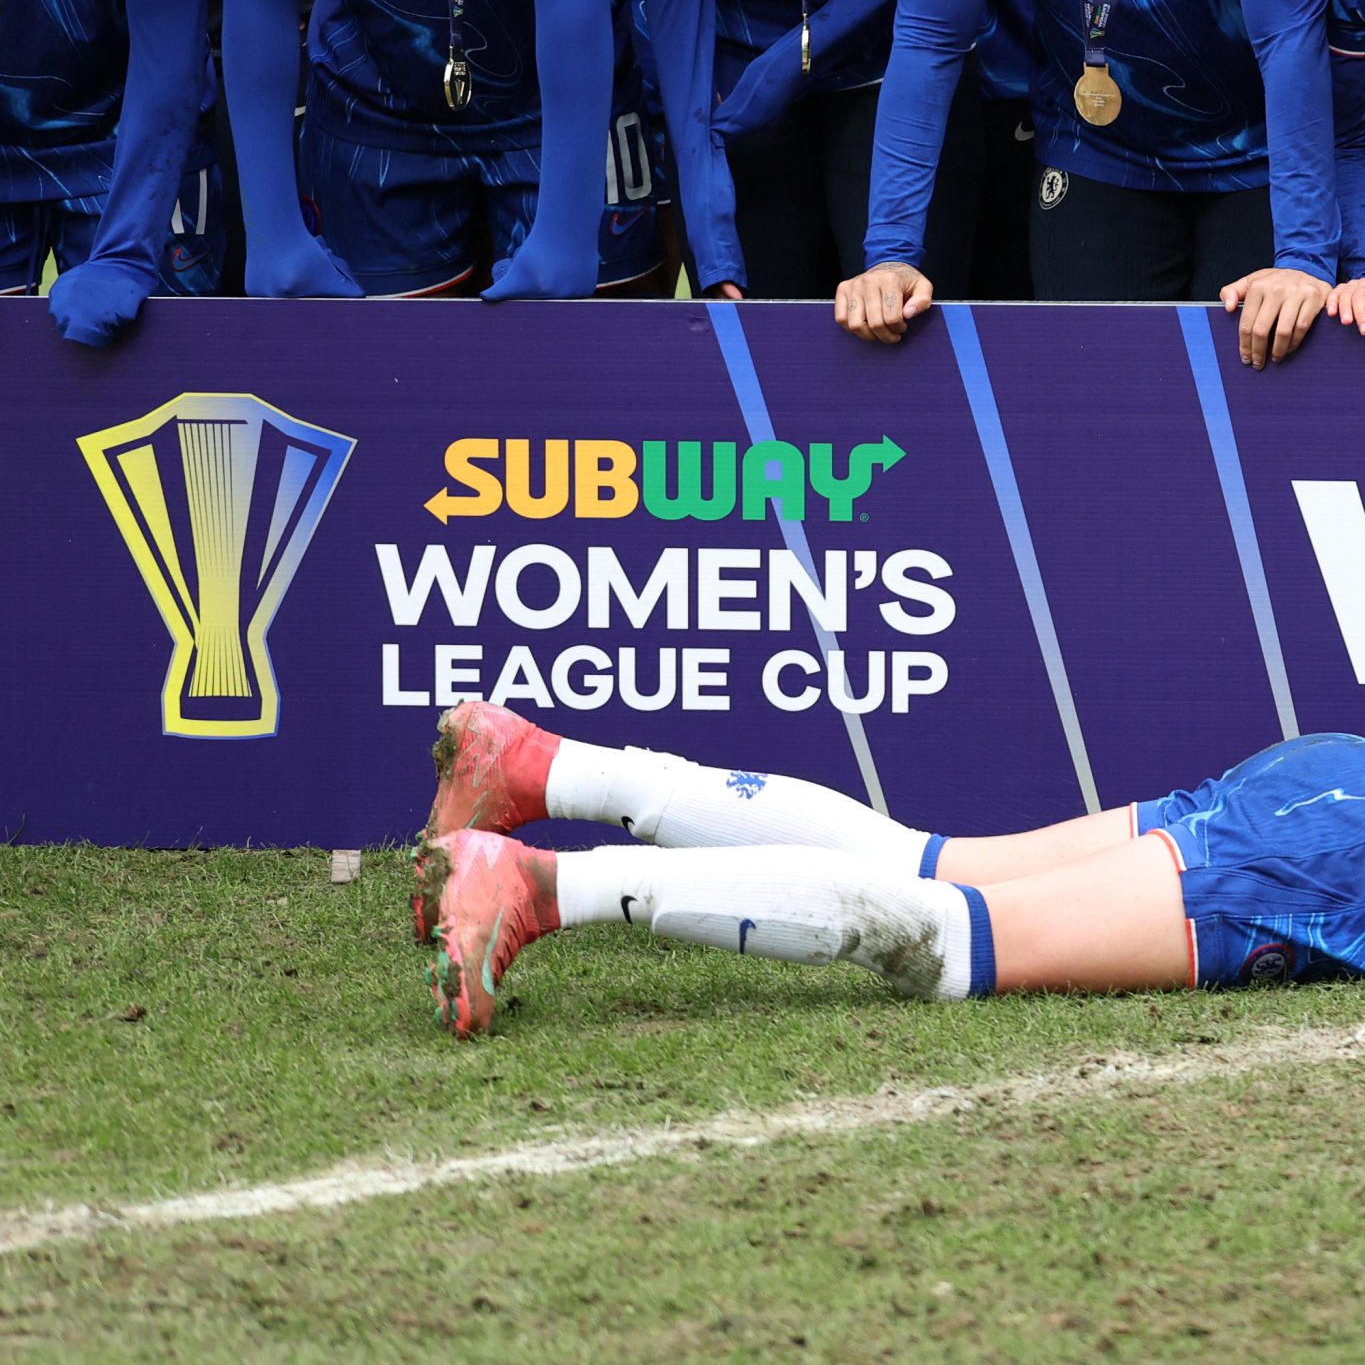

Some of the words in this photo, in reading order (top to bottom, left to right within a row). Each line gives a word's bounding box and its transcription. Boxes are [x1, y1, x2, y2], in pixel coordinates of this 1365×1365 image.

[424, 435, 906, 526] SUBWAY
[375, 543, 957, 638] WOMEN'S
[382, 643, 731, 713] LEAGUE
[761, 647, 948, 715] CUP
